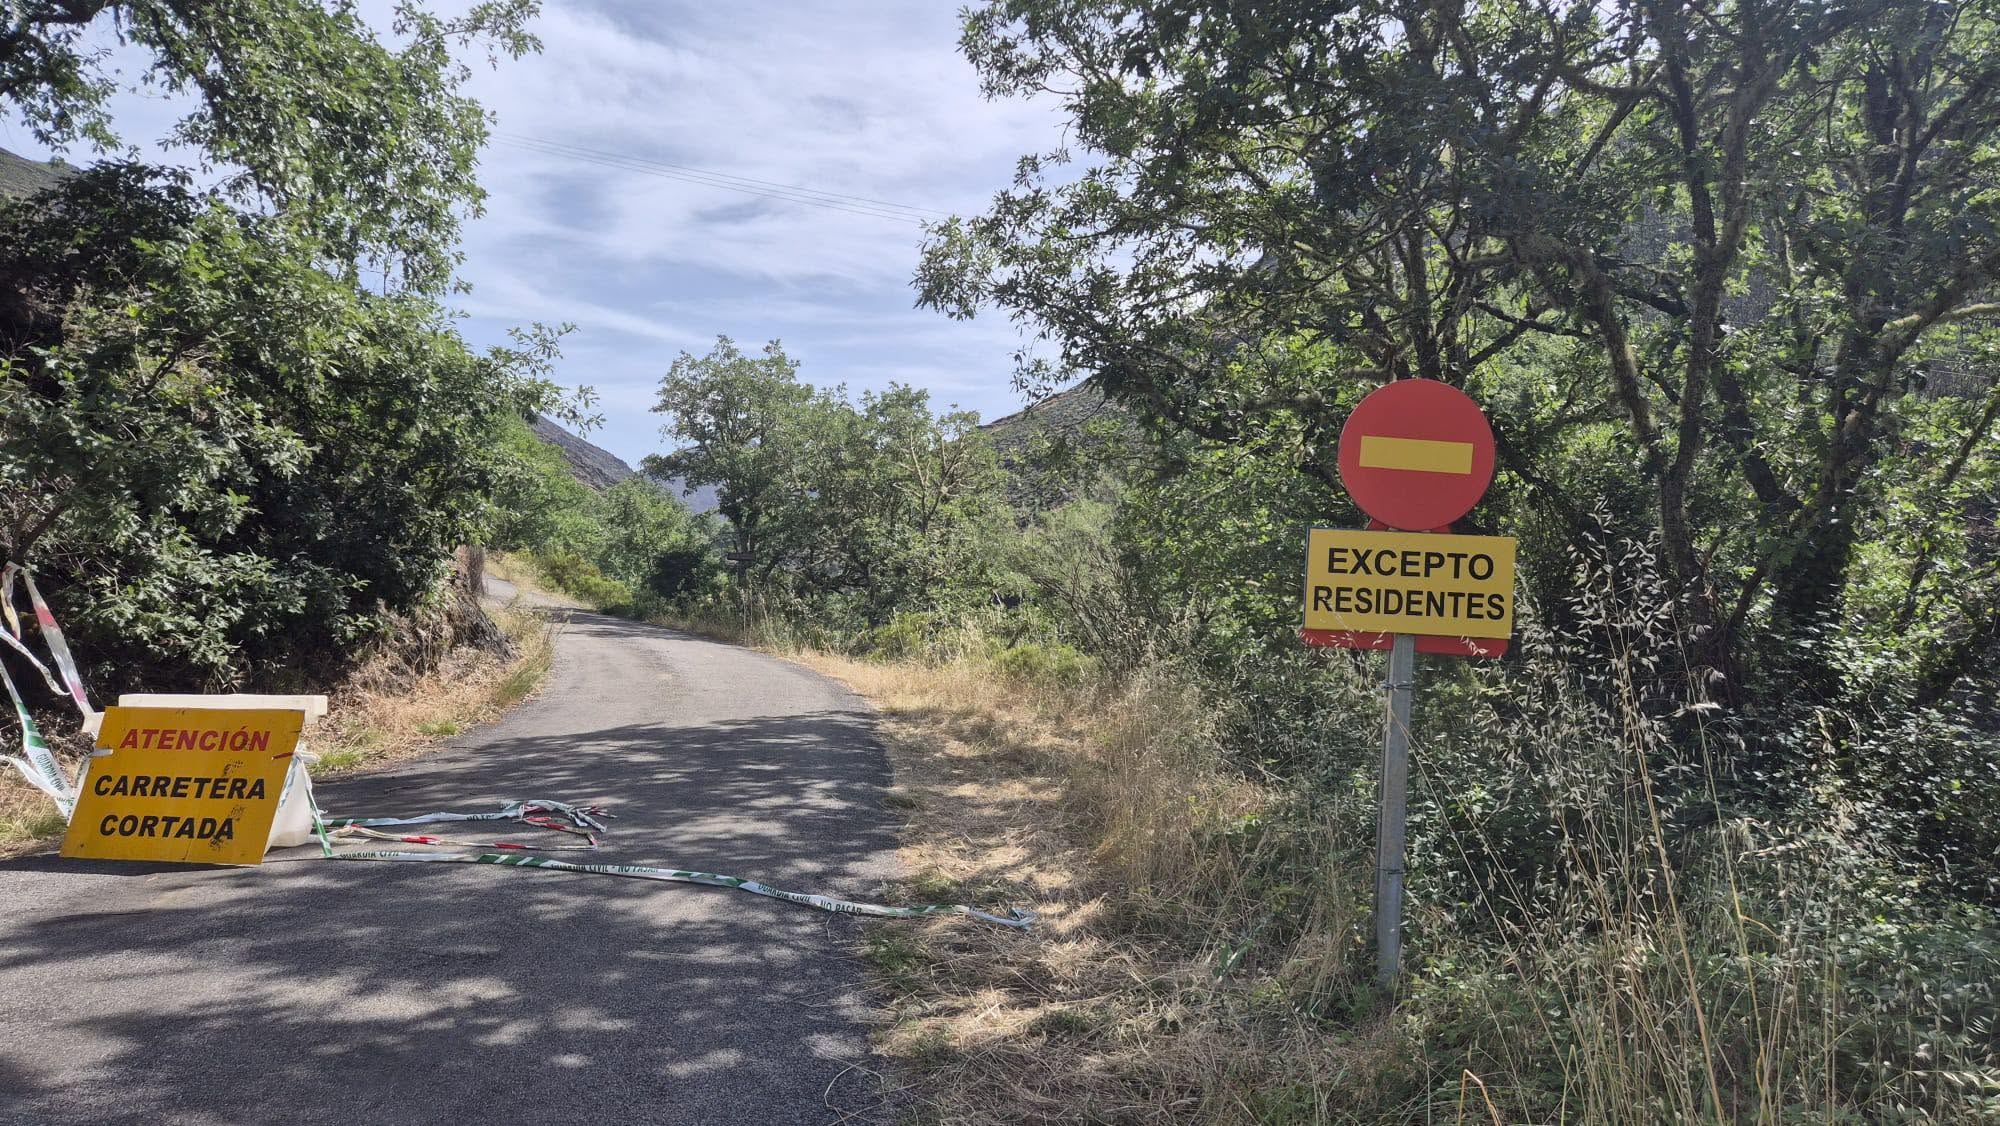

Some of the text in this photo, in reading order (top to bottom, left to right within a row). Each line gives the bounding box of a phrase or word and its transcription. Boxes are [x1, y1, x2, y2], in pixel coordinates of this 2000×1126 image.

[1328, 547, 1494, 581] EXCEPTO
[1313, 585, 1505, 620] RESIDENTES
[119, 725, 271, 752] ATENCIÓN
[94, 775, 265, 800] CARRETERA
[99, 814, 234, 840] CORTADA
